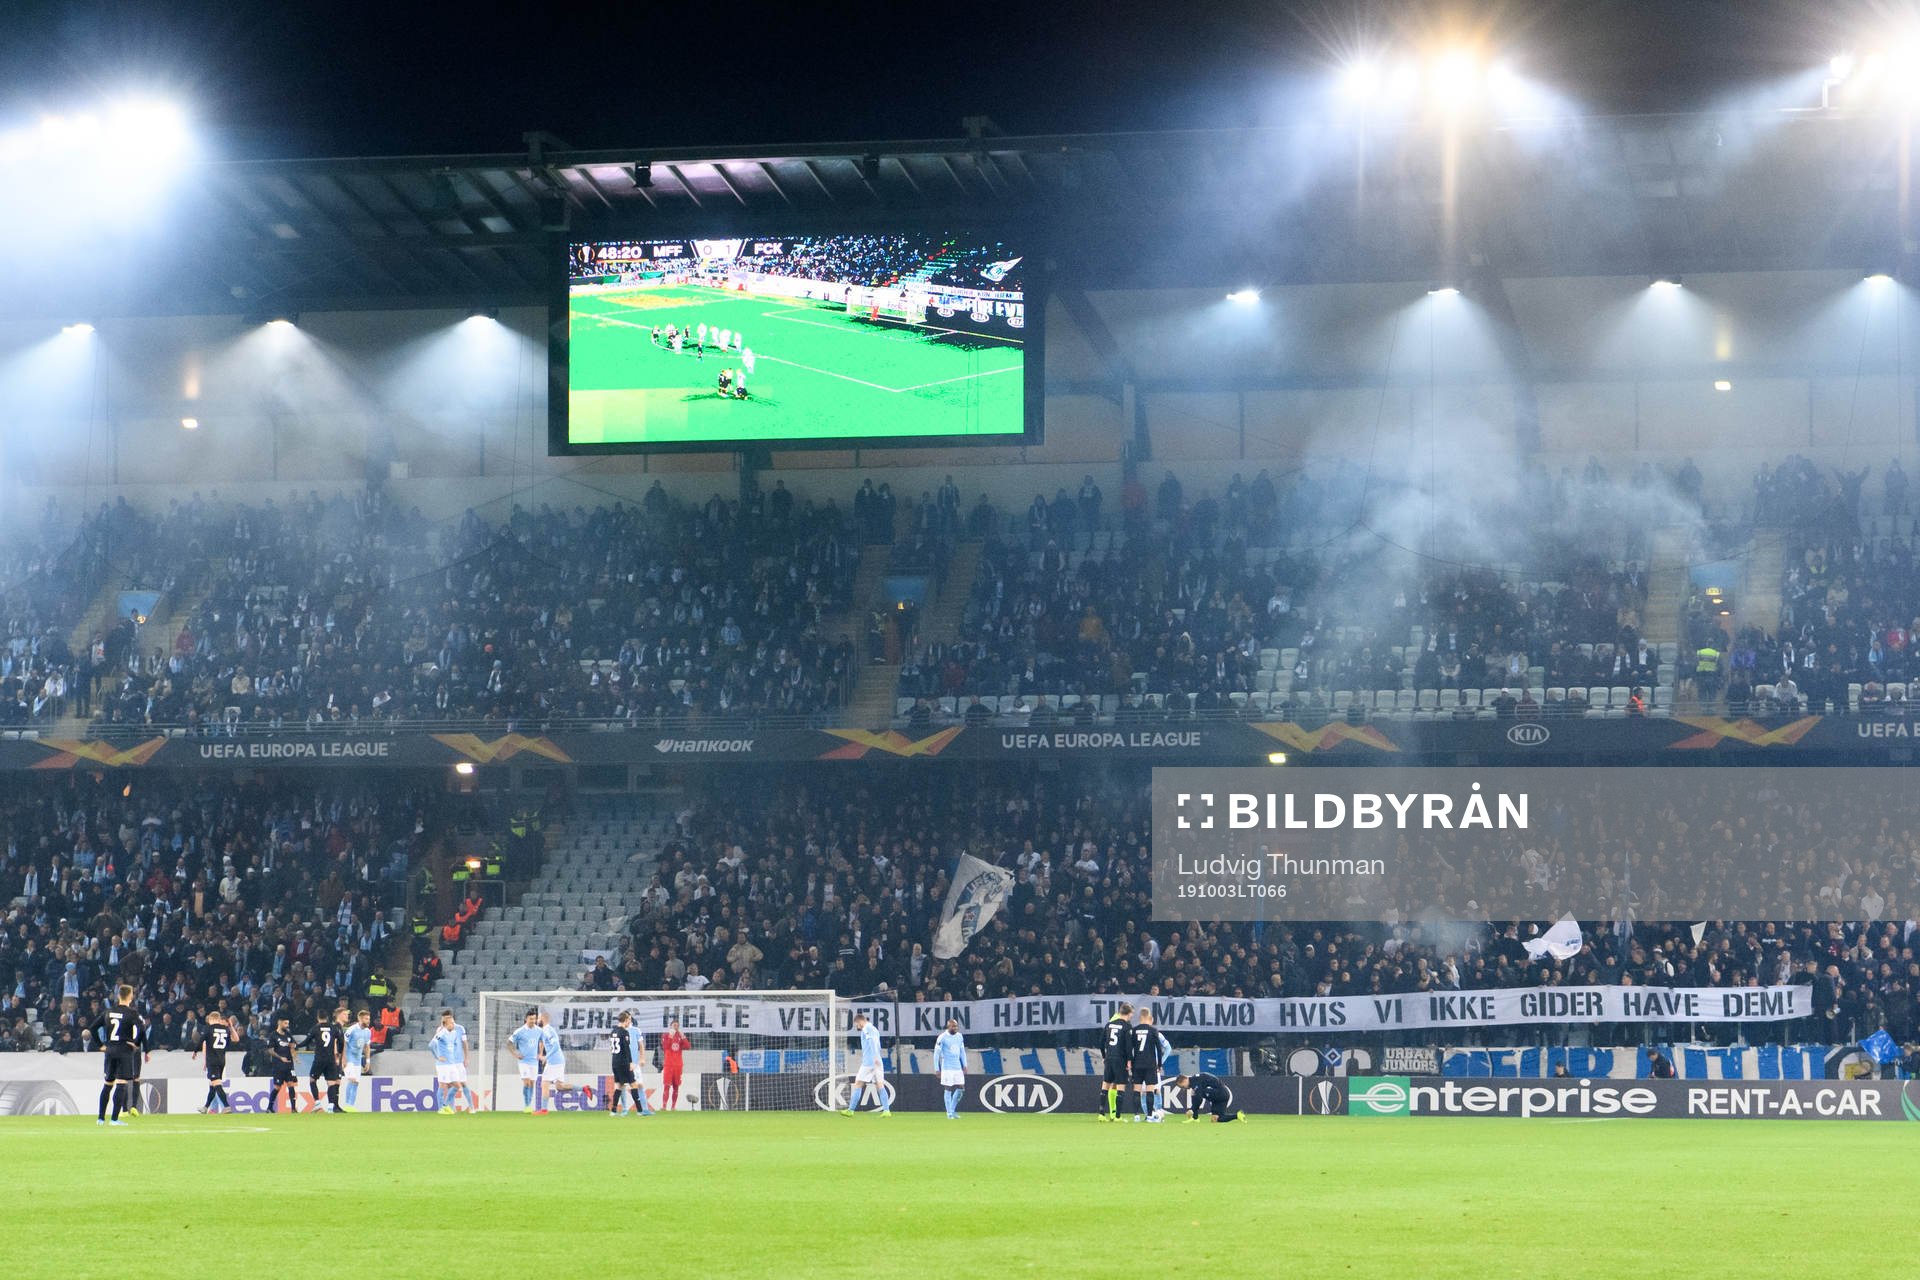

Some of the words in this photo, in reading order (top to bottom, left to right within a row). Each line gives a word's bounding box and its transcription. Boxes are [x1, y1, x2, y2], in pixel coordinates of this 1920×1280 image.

[597, 245, 642, 259] 48:20
[653, 245, 683, 258] MFF
[703, 245, 713, 255] 0
[754, 243, 783, 255] FCK
[1514, 728, 1543, 741] KIA
[1857, 722, 1908, 737] UEFA
[1001, 734, 1049, 749] UEFA
[1054, 733, 1125, 748] EUROPA
[1130, 731, 1201, 747] LEAGUE
[200, 744, 246, 759] UEFA
[250, 743, 317, 758] EUROPA
[321, 741, 389, 757] LEAGUE
[662, 1003, 750, 1029] HELTE
[915, 1005, 971, 1031] KUN
[993, 1000, 1065, 1027] HJEM
[1090, 999, 1125, 1024] TI
[1151, 1001, 1255, 1026] MALMØ
[1279, 1001, 1346, 1027] HVIS
[1374, 998, 1403, 1024] VI
[1429, 996, 1496, 1021] IKKE
[1520, 991, 1604, 1017] GIDER
[1623, 992, 1700, 1017] HAVE
[1722, 990, 1794, 1017] DEM!
[110, 1018, 120, 1042] 2
[321, 1031, 331, 1047] 9
[1108, 1028, 1119, 1046] 5
[212, 1033, 228, 1049] 25
[1137, 1034, 1148, 1052] 7
[1385, 1047, 1435, 1059] URBAN
[1381, 1058, 1438, 1072] JUNIORS
[993, 1084, 1051, 1107] KIA
[1360, 1078, 1657, 1118] enterprise
[1687, 1088, 1881, 1116] RENT-A-CAR
